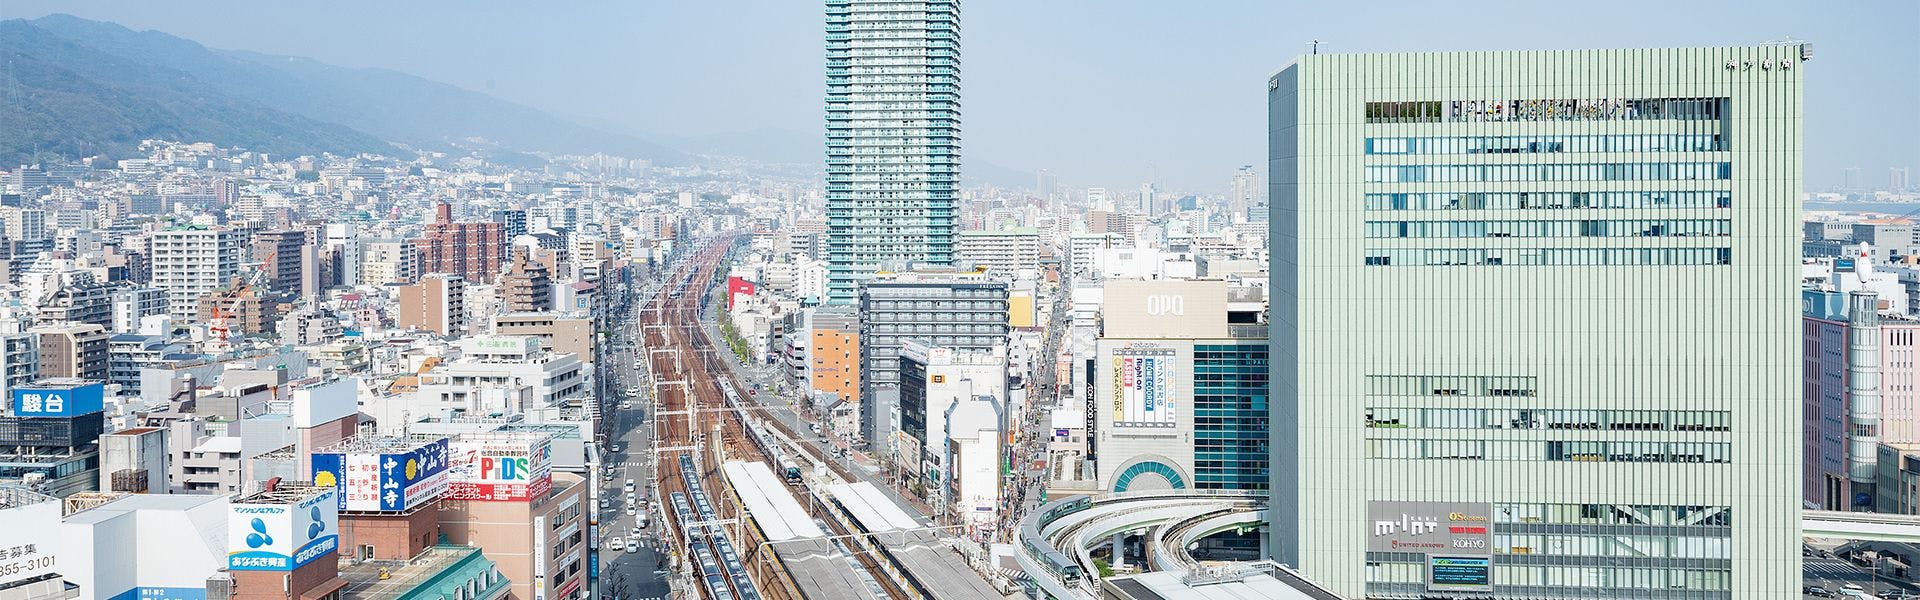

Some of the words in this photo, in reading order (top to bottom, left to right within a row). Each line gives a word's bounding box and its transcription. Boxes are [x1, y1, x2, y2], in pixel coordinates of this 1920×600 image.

[22, 393, 64, 412] 駿台
[416, 444, 447, 478] 中山寺
[382, 457, 399, 508] 中山寺
[1453, 539, 1485, 549] KOHYO
